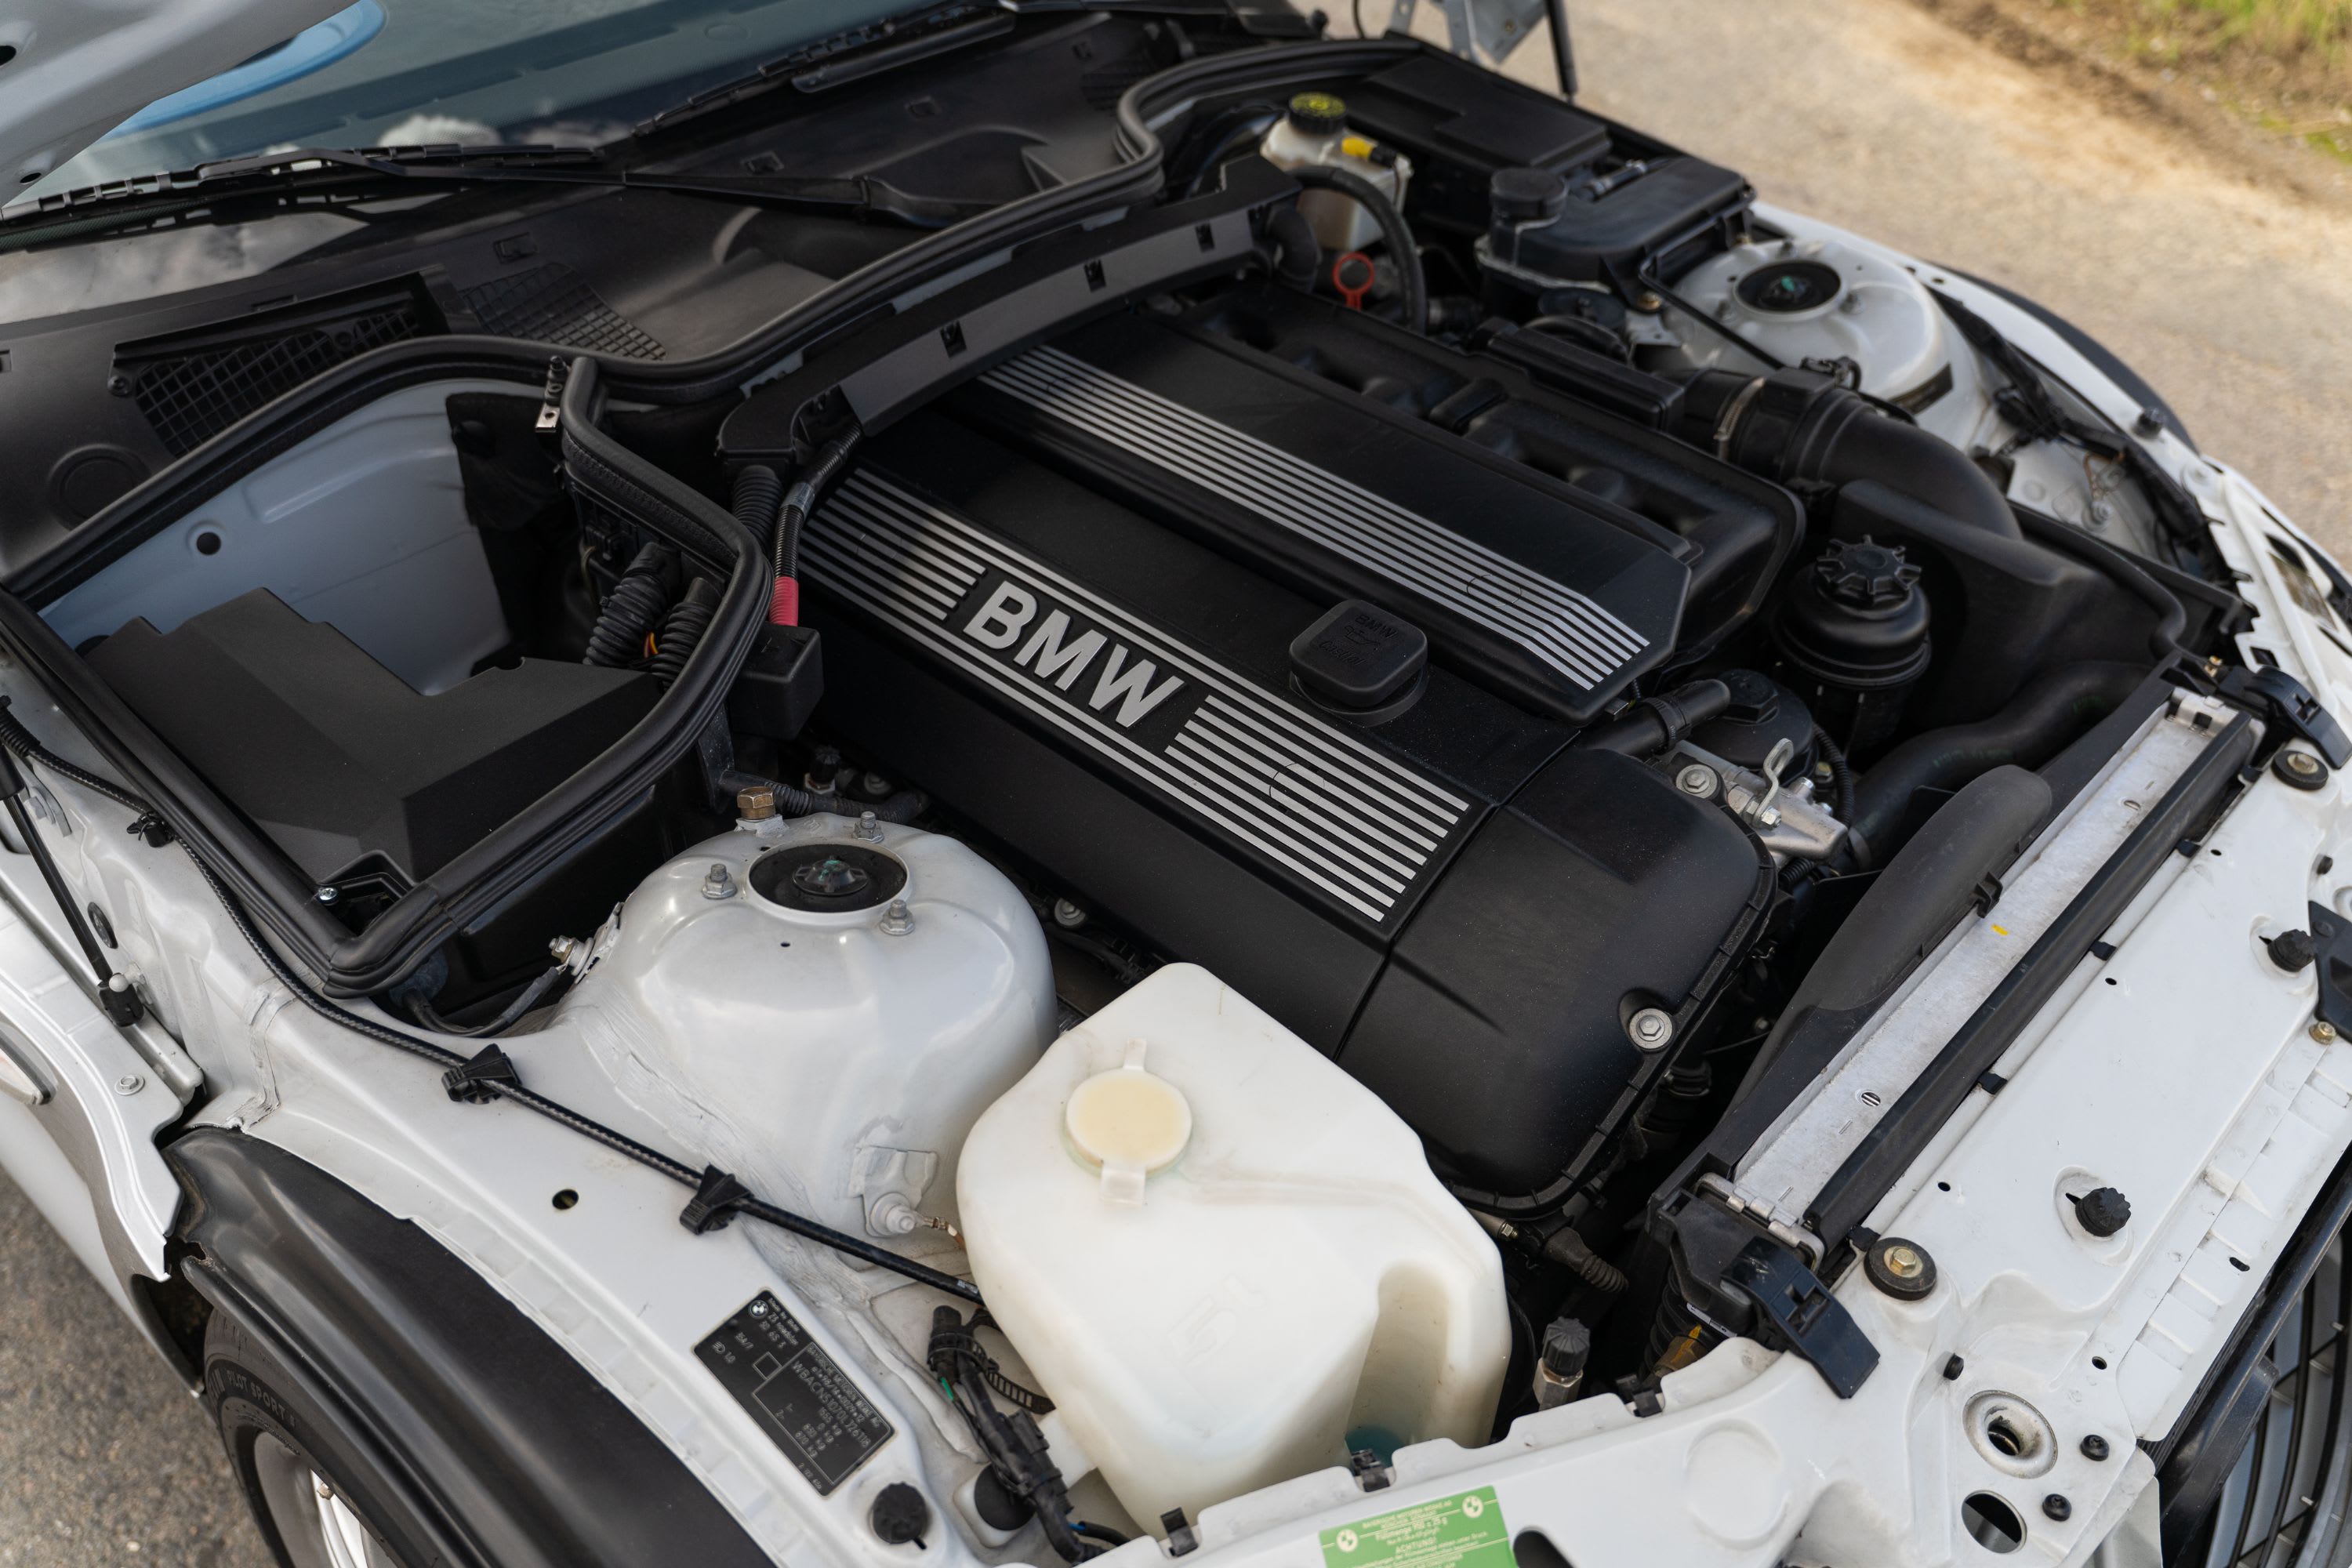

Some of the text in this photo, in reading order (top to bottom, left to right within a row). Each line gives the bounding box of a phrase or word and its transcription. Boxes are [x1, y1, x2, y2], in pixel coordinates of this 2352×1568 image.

[1355, 613, 1399, 640] BMW
[963, 581, 1185, 728] BMW
[227, 1370, 248, 1392] PILOT
[251, 1382, 285, 1420] SPORT
[834, 1374, 856, 1399] MOTOREN
[856, 1400, 872, 1416] WERKE
[870, 1417, 880, 1427] AG
[824, 1431, 833, 1443] kg
[832, 1424, 842, 1436] kg
[808, 1446, 818, 1458] kg
[815, 1439, 826, 1450] kg
